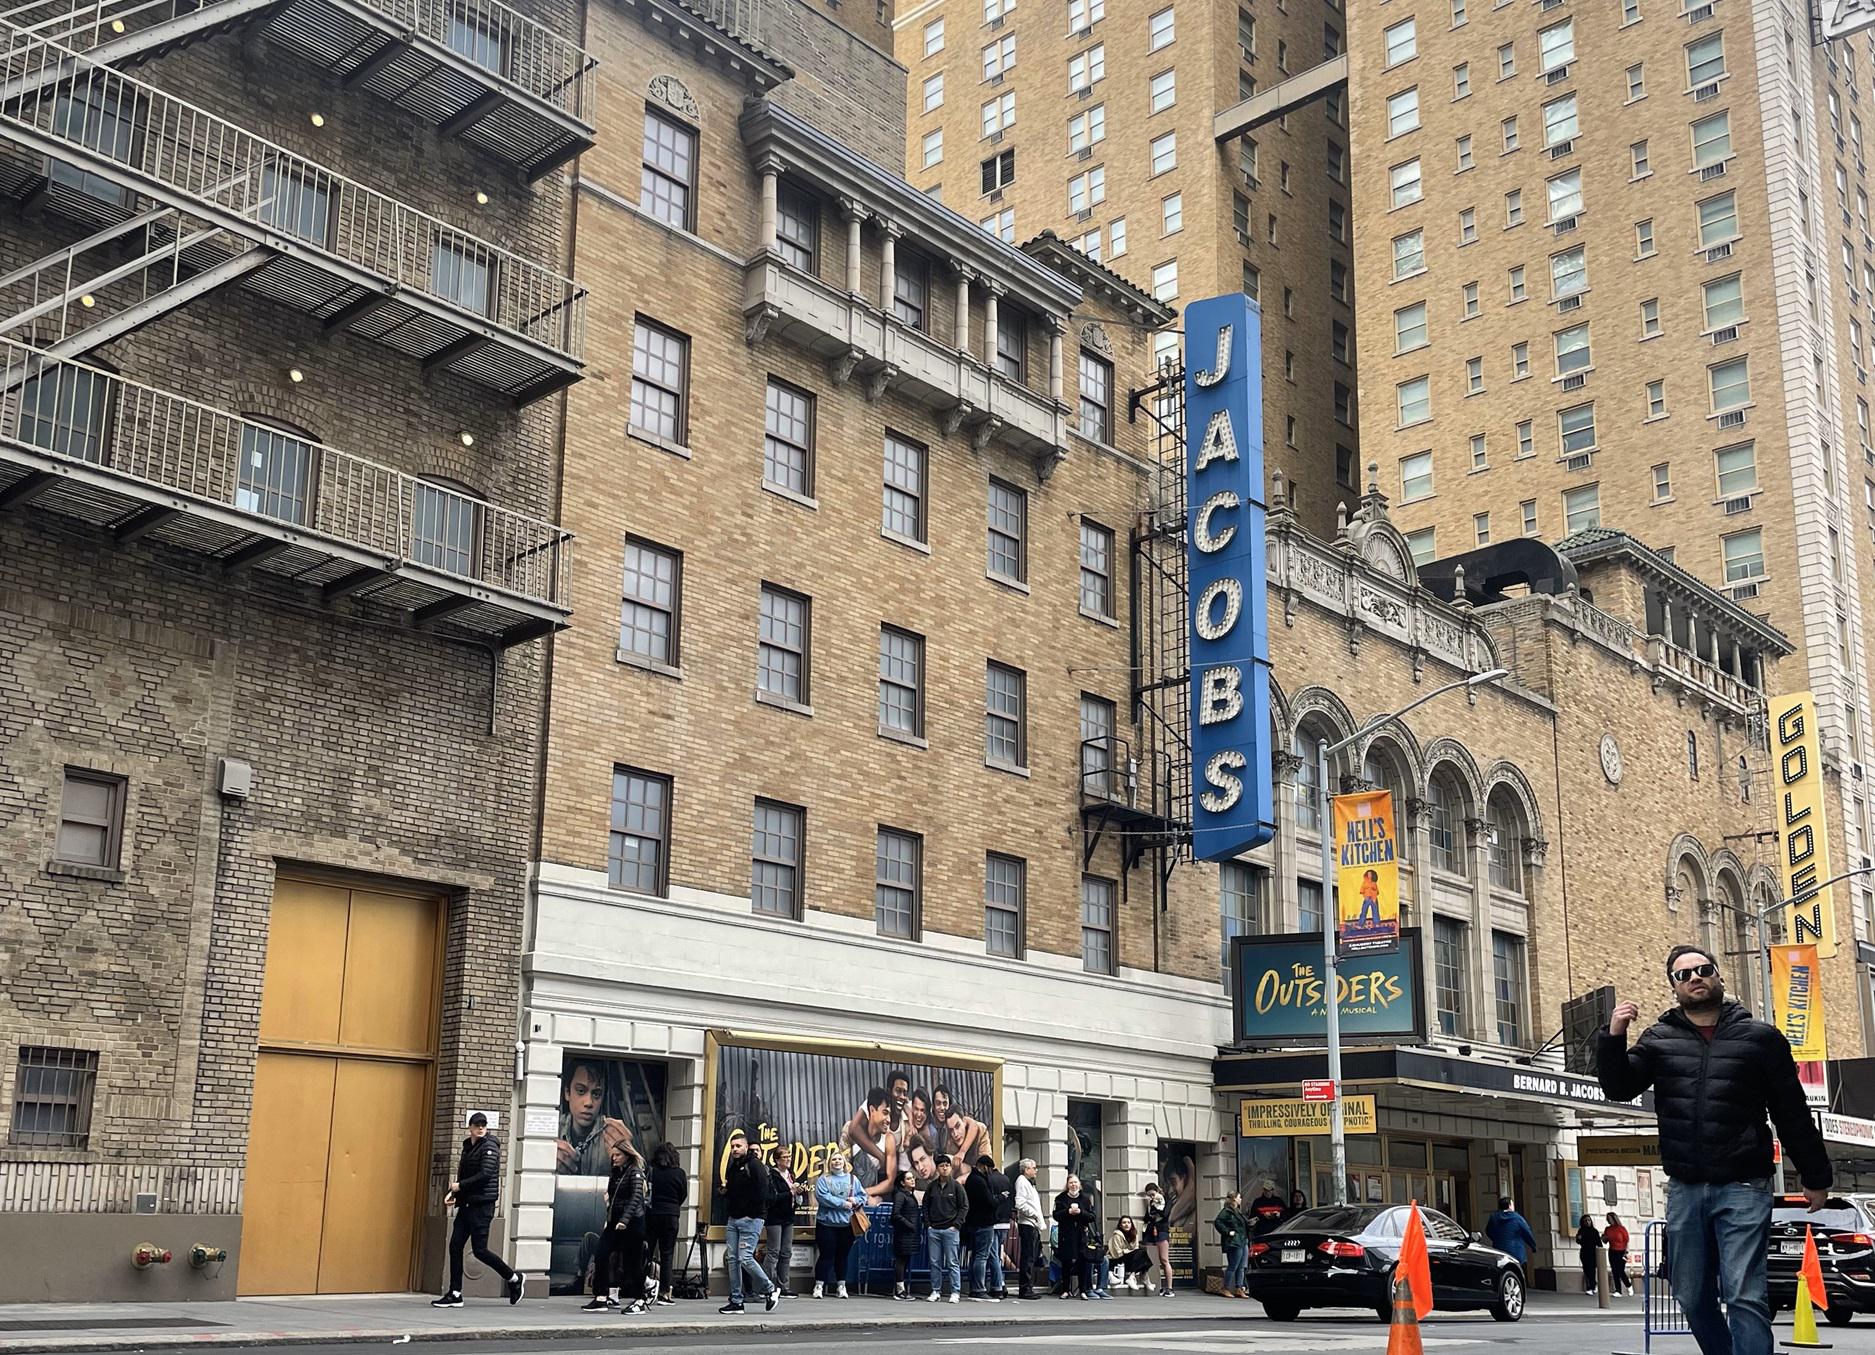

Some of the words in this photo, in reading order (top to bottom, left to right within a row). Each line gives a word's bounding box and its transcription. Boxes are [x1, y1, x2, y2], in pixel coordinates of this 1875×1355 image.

[1194, 324, 1247, 814] JACOBS
[1347, 816, 1385, 843] HELL'S
[1778, 703, 1822, 943] GOLDEN
[1341, 838, 1394, 866] KITCHEN
[1291, 962, 1315, 977] THE
[1788, 965, 1809, 1010] KITCHEN
[1341, 1006, 1377, 1015] MUSICAL
[1786, 1013, 1806, 1046] HELL'S
[1513, 1074, 1557, 1094] BERNARD
[1559, 1082, 1569, 1096] B.
[1570, 1083, 1605, 1102] JACOBS
[758, 1122, 779, 1141] THE
[1284, 1118, 1328, 1128] COURAGEOUS
